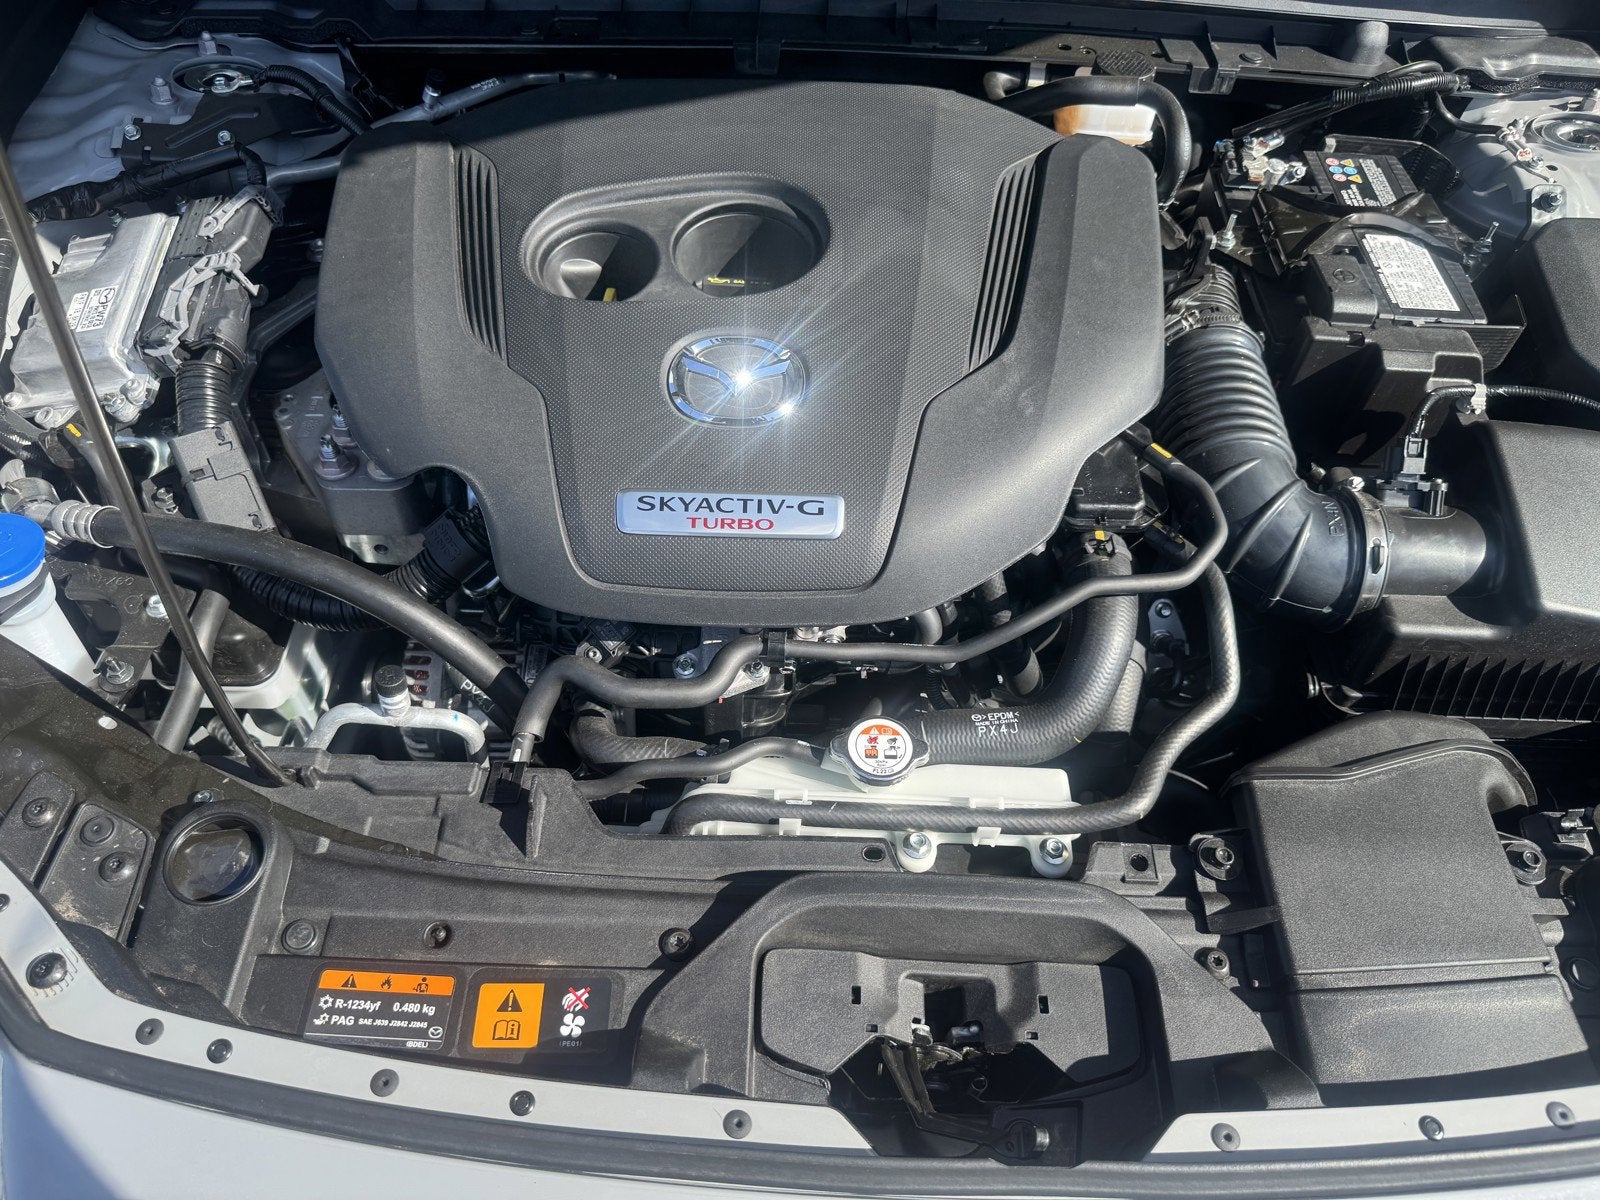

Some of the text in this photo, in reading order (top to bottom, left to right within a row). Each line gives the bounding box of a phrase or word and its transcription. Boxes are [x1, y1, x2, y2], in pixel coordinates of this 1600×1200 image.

[636, 495, 825, 516] SKYACTIV-G
[686, 517, 775, 531] TURBO
[335, 998, 436, 1016] R-1234yf 0.480 kg
[330, 1015, 355, 1026] PAG
[373, 1019, 388, 1027] J639
